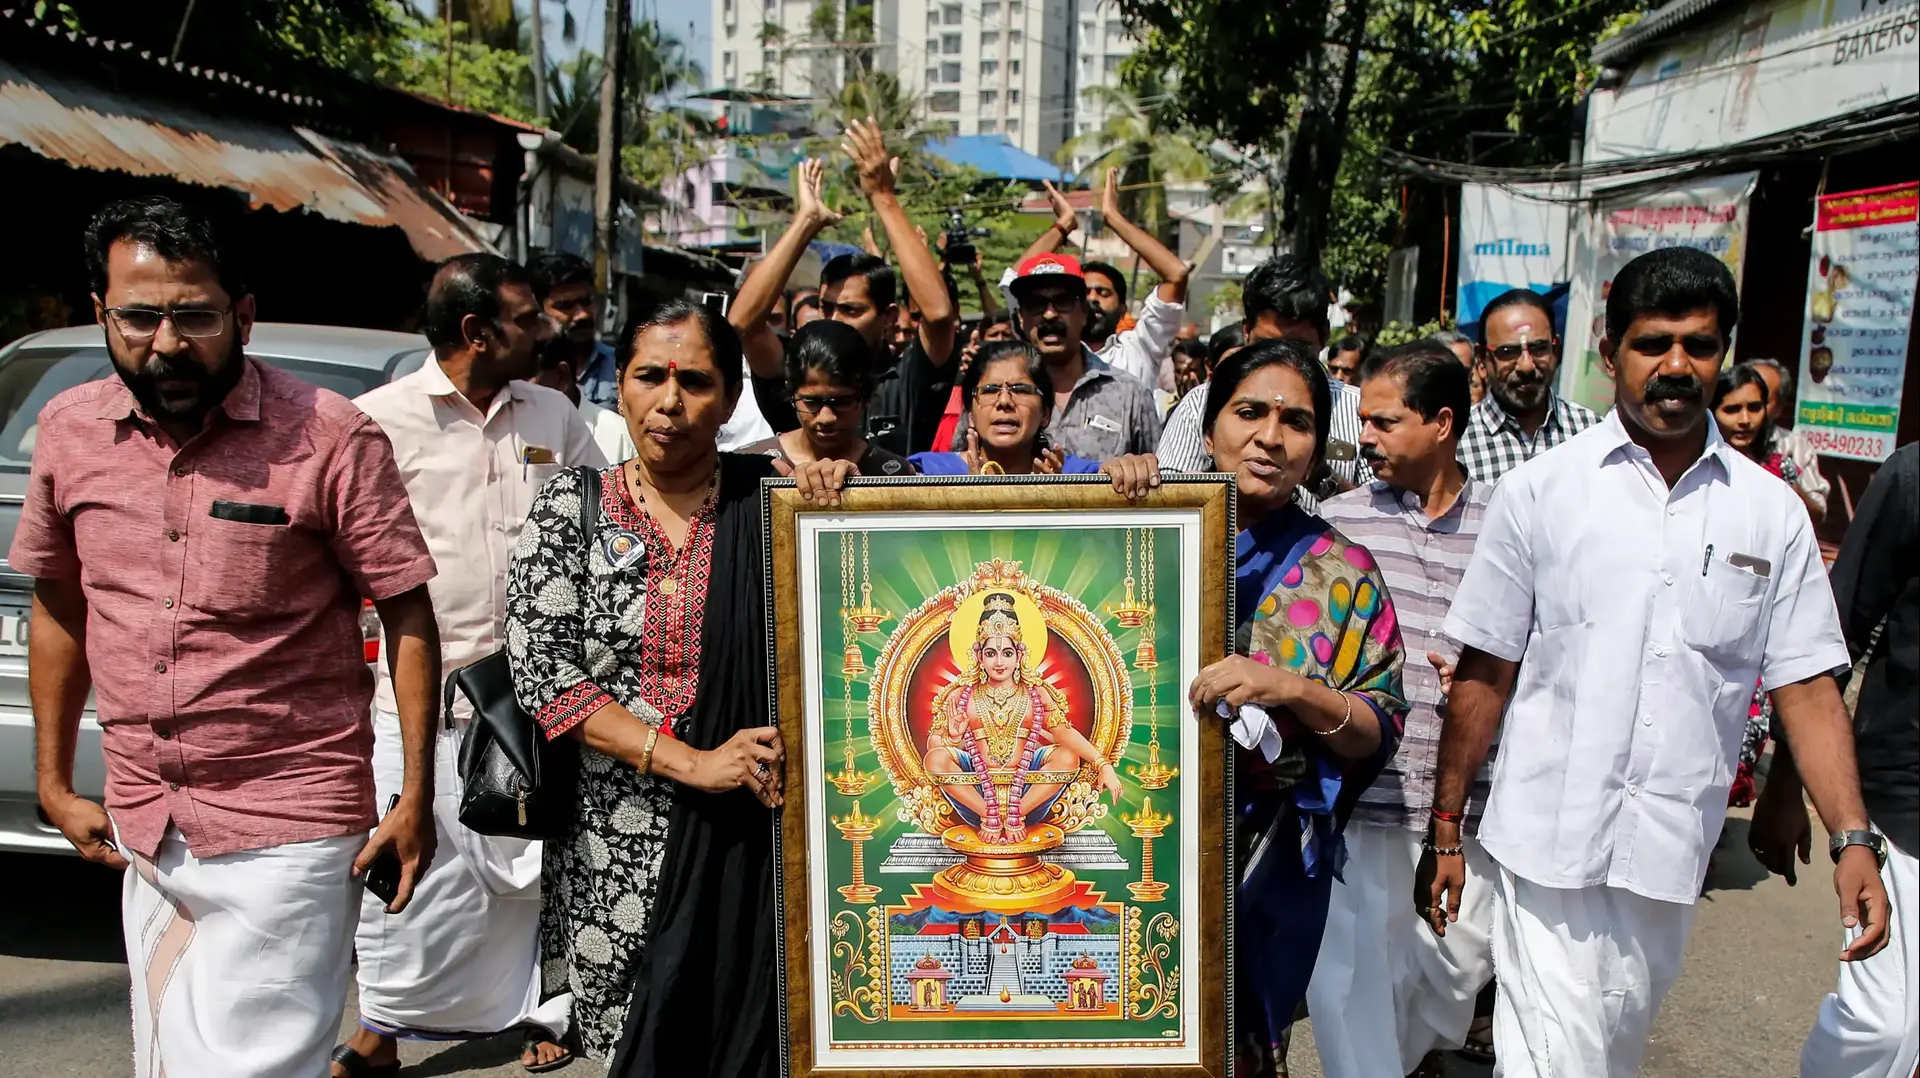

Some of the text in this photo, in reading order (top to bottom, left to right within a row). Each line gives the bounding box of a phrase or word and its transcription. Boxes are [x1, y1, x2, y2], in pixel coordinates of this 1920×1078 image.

[1832, 8, 1919, 66] BAKERS
[1474, 238, 1551, 256] milma
[1801, 429, 1884, 458] 895490233
